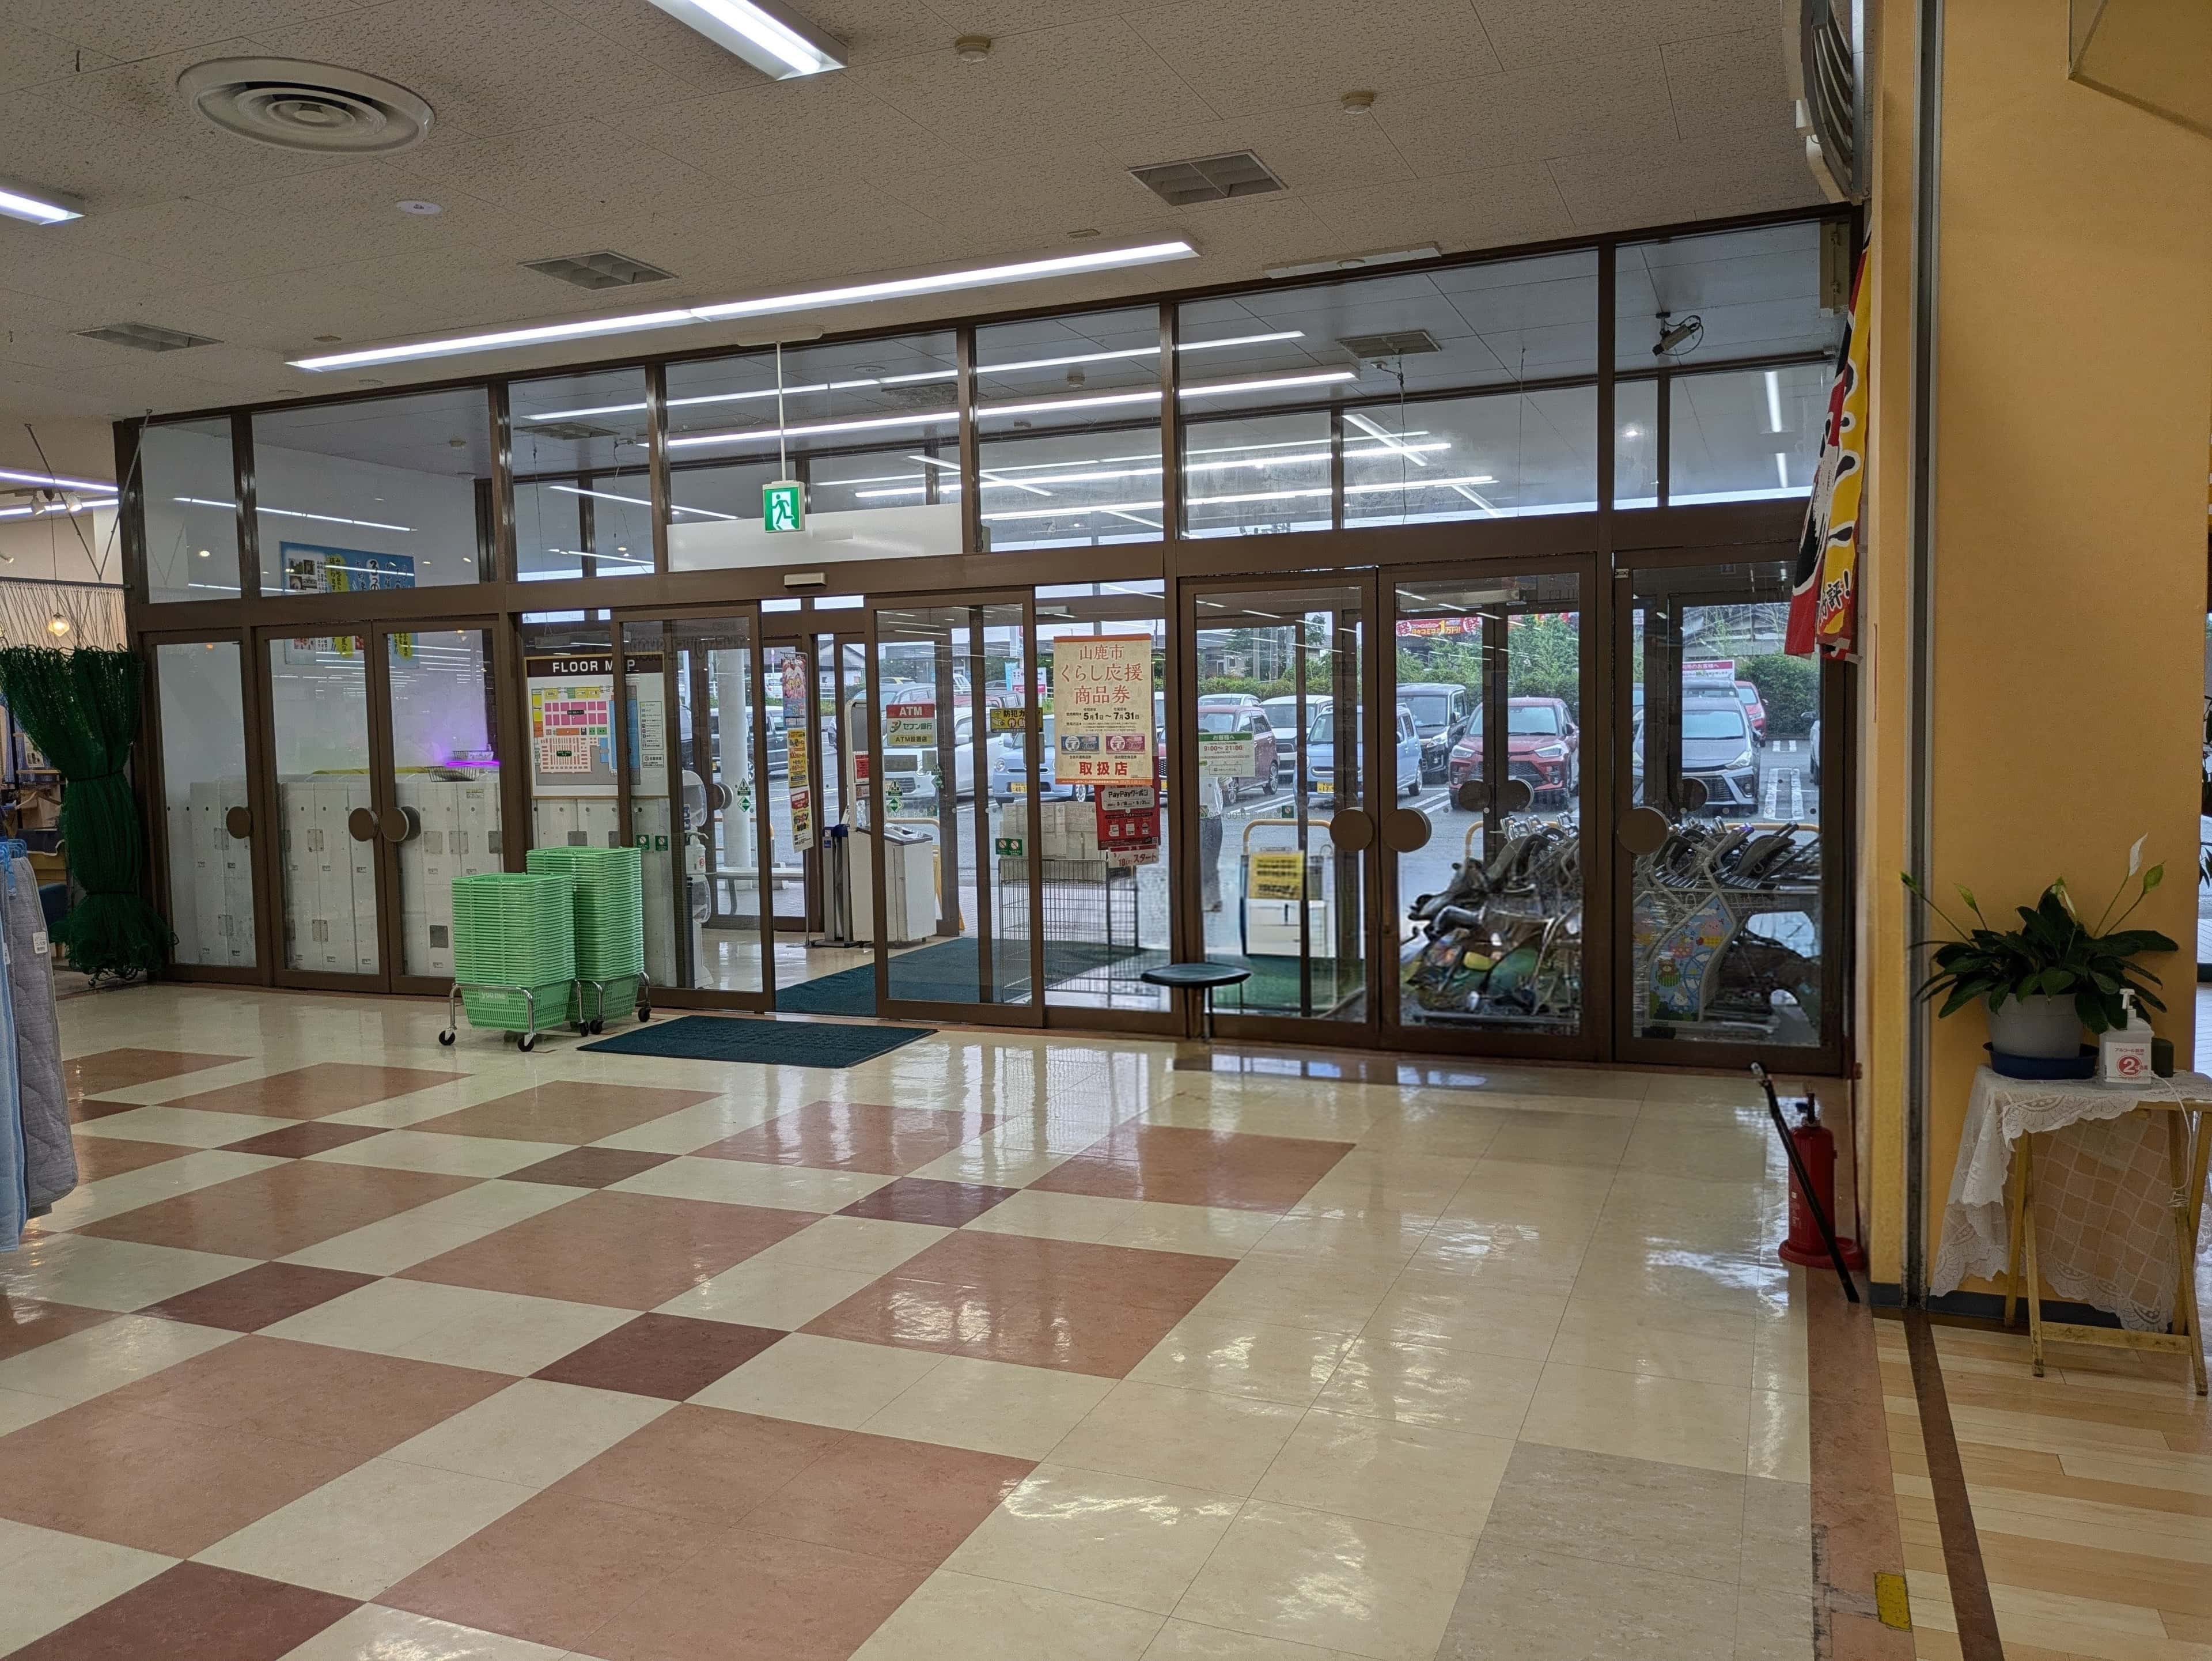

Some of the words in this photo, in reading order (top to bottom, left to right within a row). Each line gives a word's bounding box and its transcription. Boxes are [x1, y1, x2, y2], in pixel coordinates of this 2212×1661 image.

[1080, 644, 1124, 660] 山鹿市
[553, 661, 599, 673] FLOOR
[605, 659, 635, 671] MP
[1062, 663, 1143, 682] くらし応援
[1074, 684, 1130, 704] 商品券
[900, 706, 922, 716] ATM
[903, 722, 932, 731] セブン銀行
[1079, 761, 1128, 775] 取扱店
[1134, 853, 1157, 863] スタート
